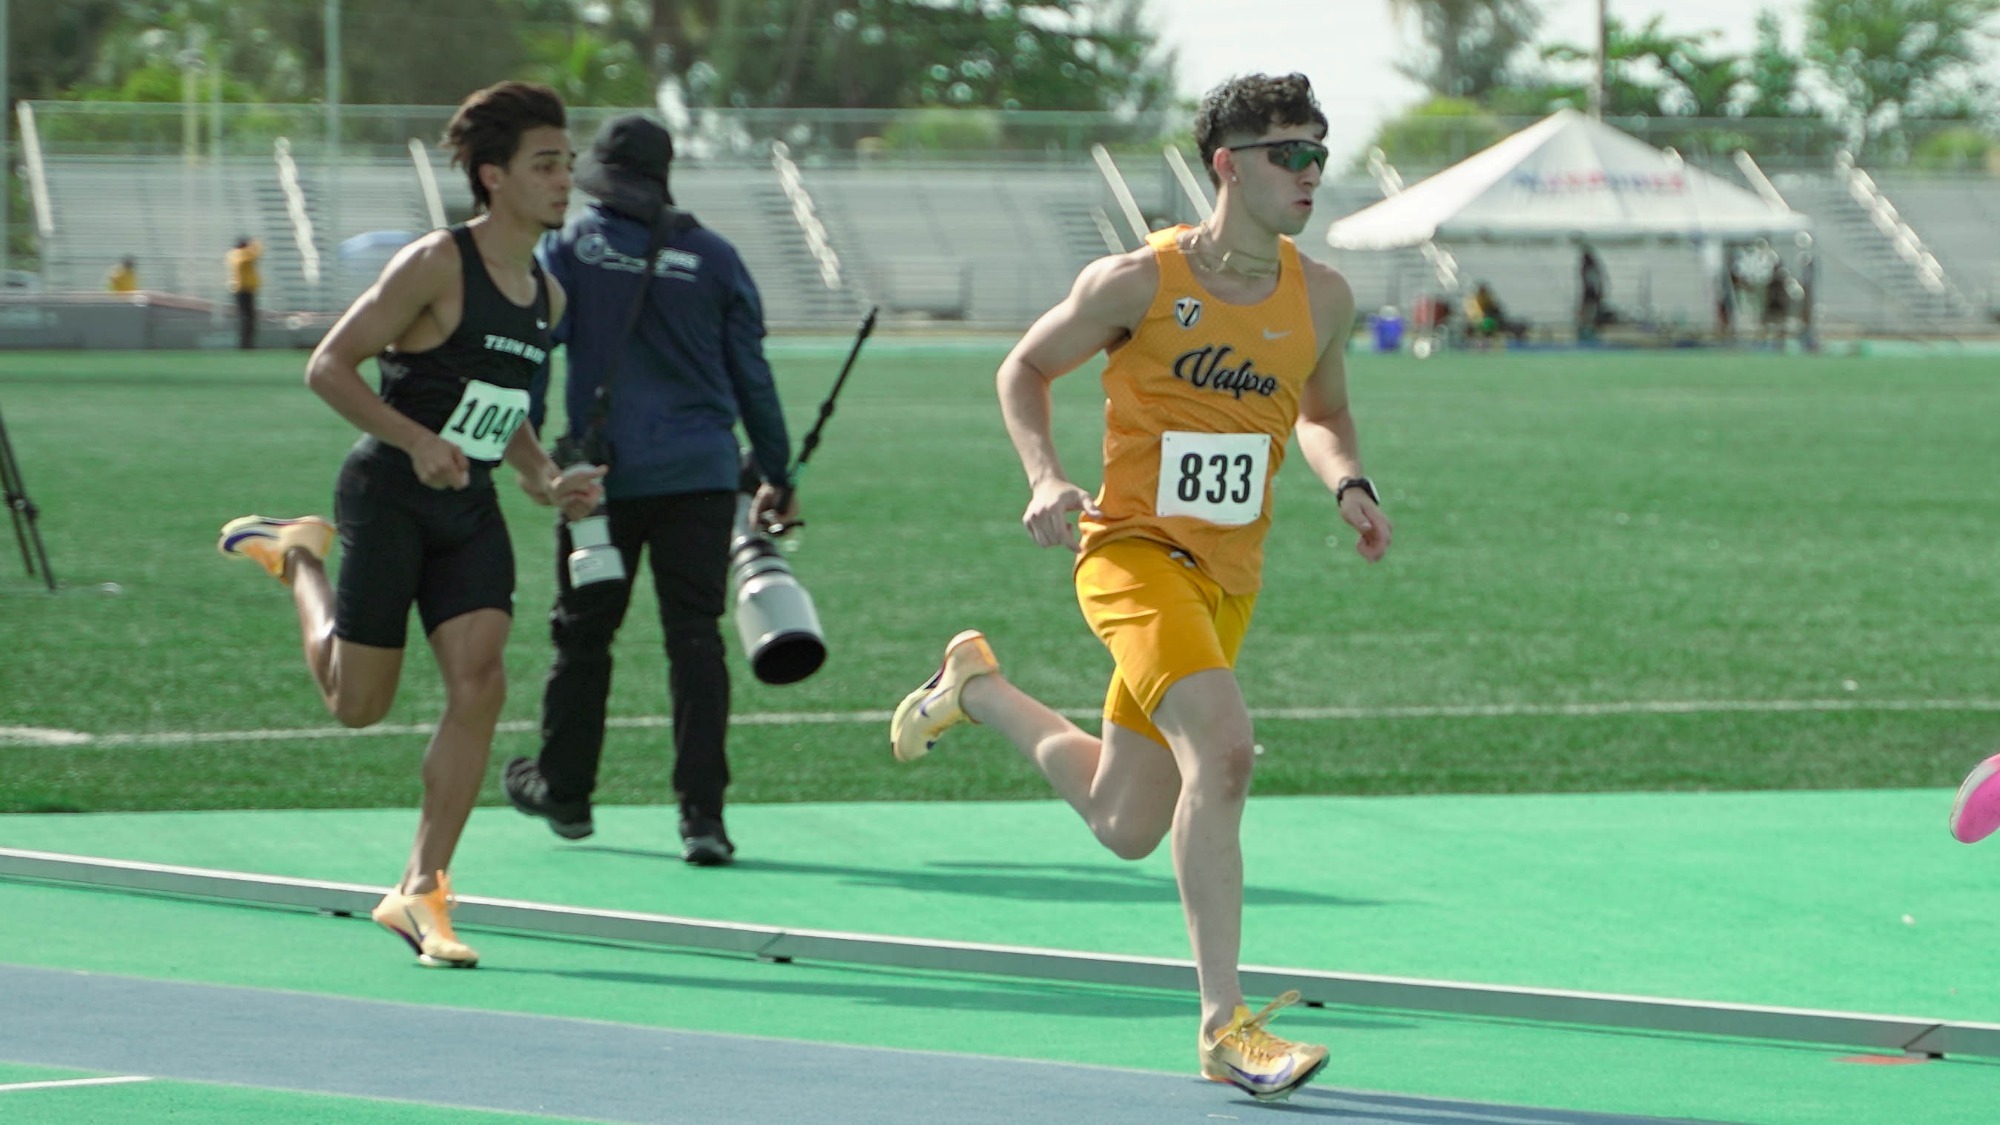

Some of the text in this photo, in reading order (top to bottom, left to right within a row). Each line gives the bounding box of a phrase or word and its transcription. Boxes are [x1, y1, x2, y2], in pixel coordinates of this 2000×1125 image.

[483, 334, 526, 357] TEAM
[1173, 345, 1277, 400] Valpo
[1177, 452, 1253, 504] 833
